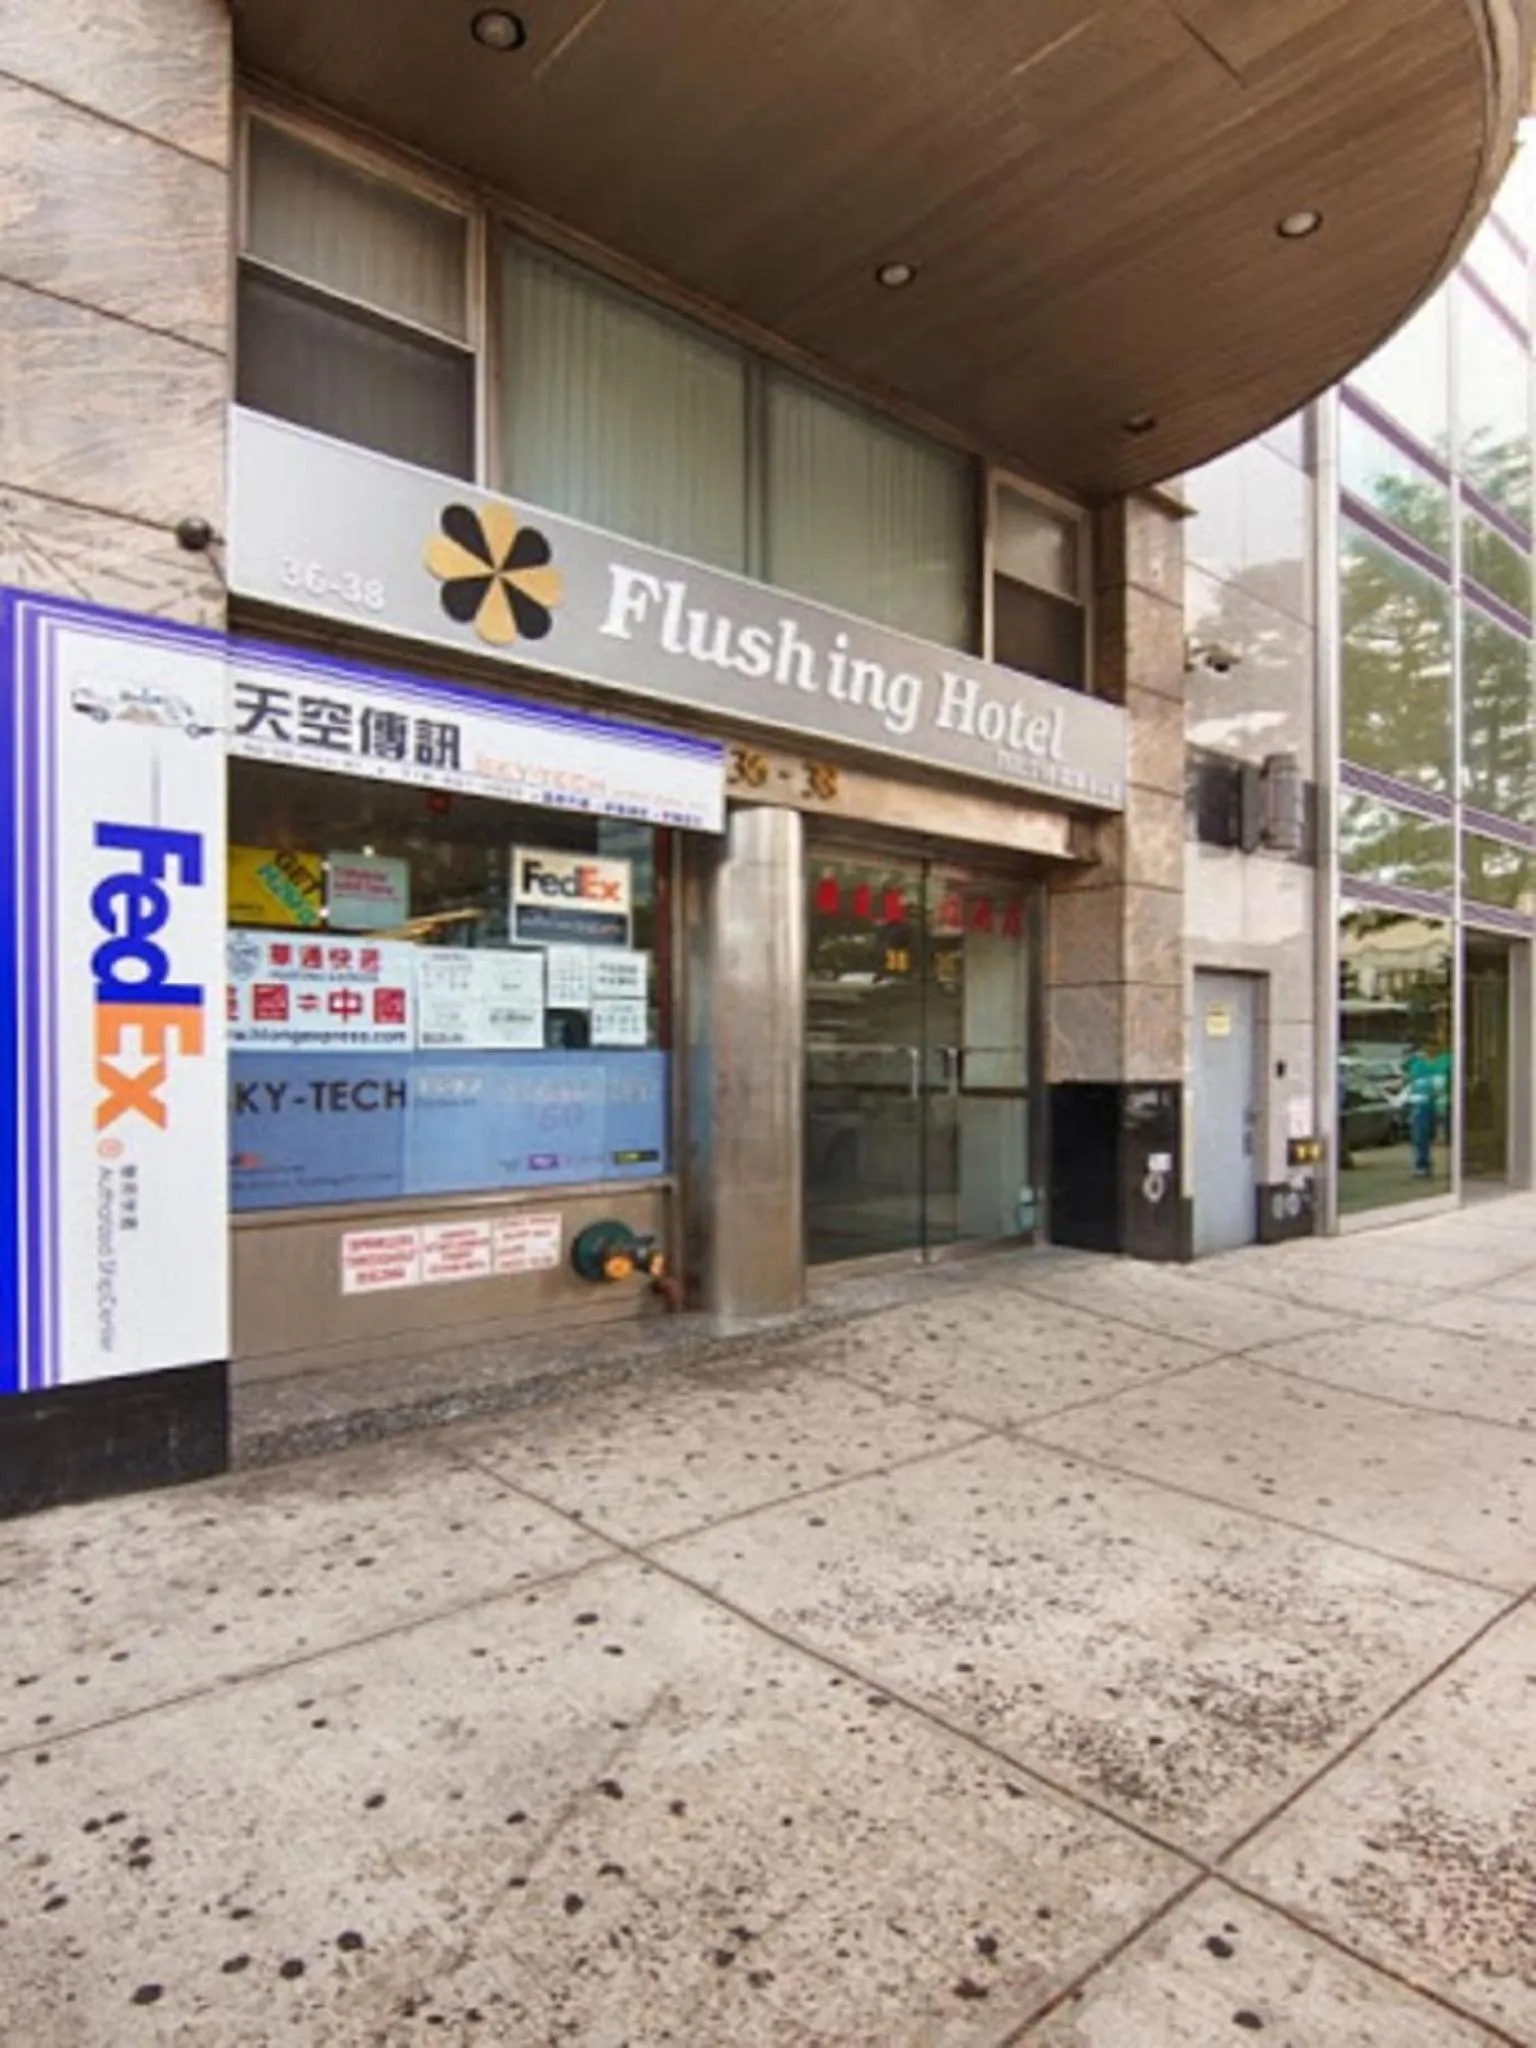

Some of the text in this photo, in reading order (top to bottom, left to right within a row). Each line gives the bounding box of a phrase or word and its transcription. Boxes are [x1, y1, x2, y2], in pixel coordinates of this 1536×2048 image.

[280, 556, 385, 610] 36-38
[599, 563, 1066, 762] Flushing Hotel
[234, 681, 461, 772] 天空傳訊
[522, 859, 621, 903] FedEx
[90, 822, 204, 1131] FedEx
